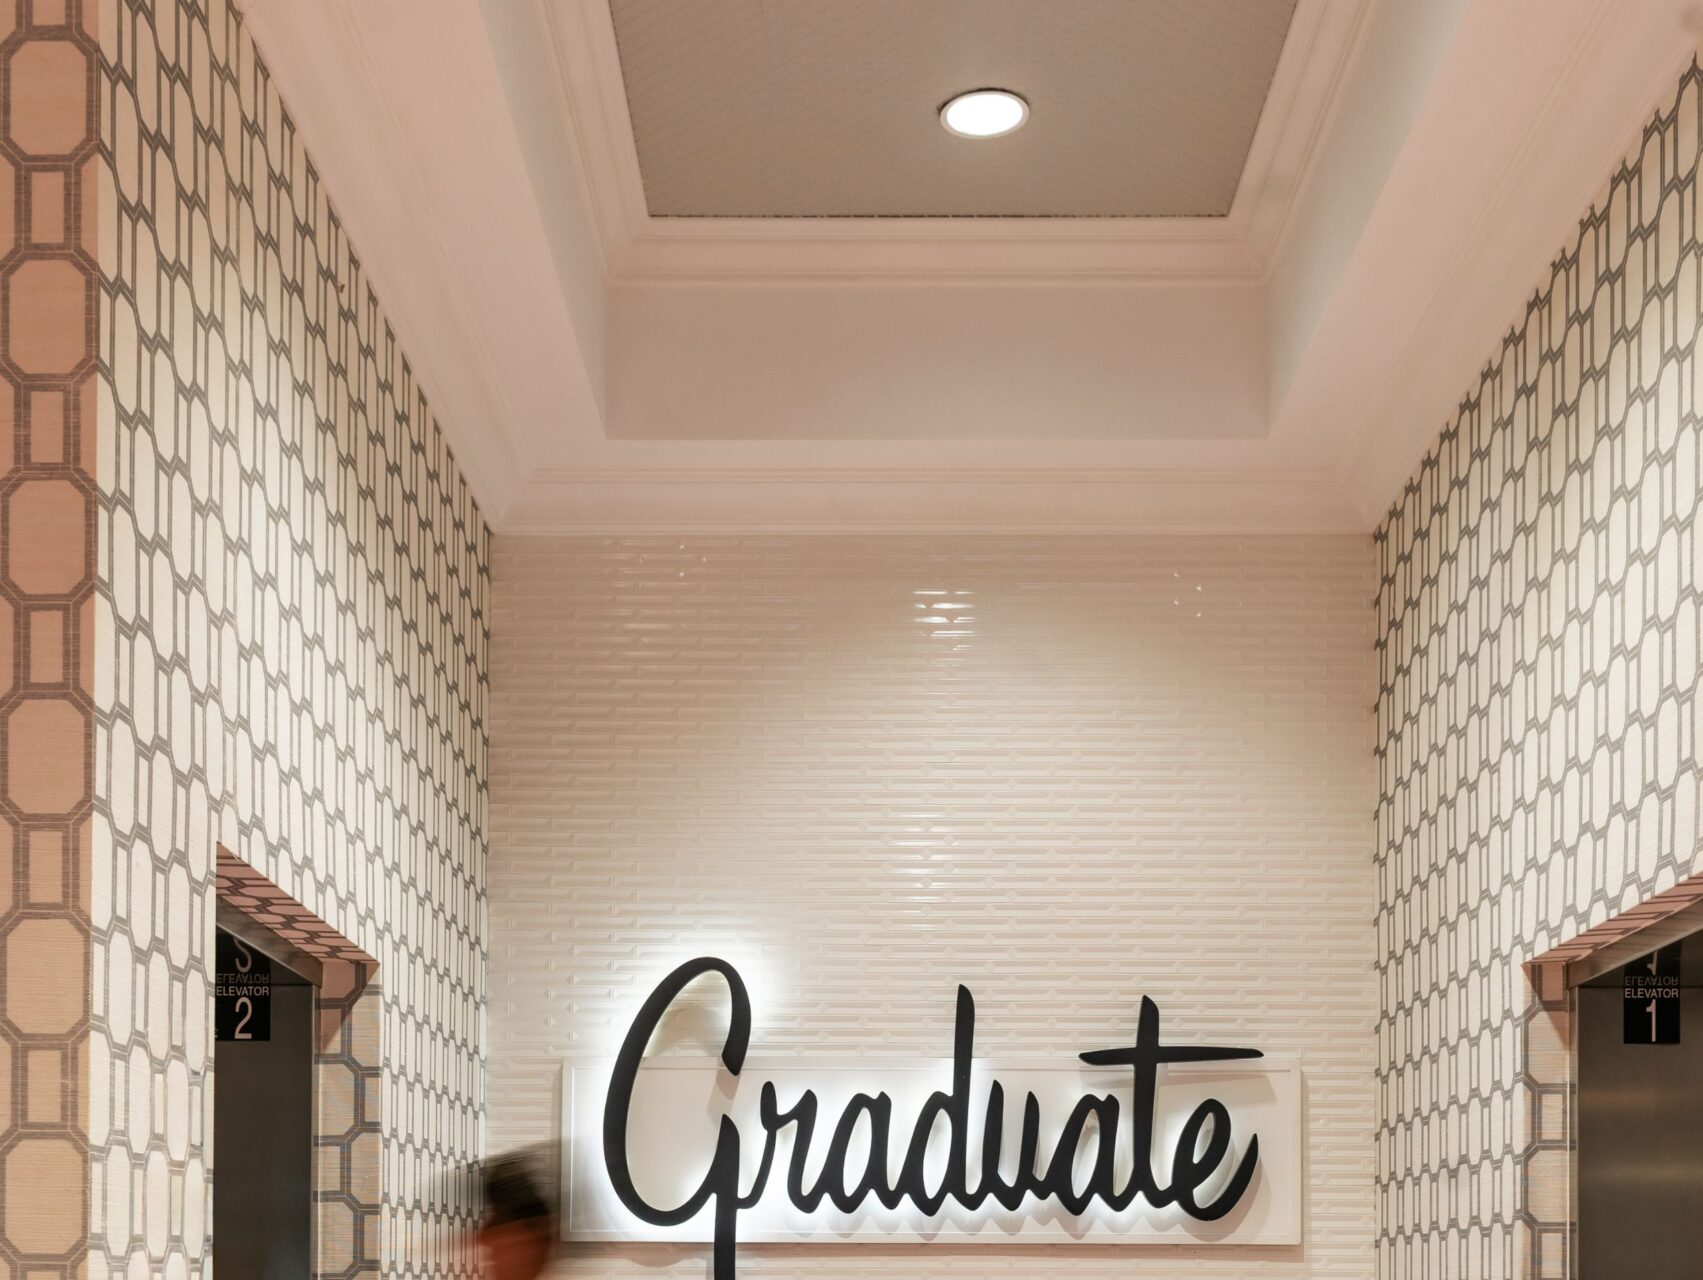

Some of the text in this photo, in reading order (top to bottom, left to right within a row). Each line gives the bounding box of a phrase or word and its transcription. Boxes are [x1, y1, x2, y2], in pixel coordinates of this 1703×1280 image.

[216, 986, 270, 996] ELEVATOR
[1624, 988, 1679, 999] ELEVATOR
[234, 997, 253, 1040] 2
[1645, 999, 1657, 1042] 1
